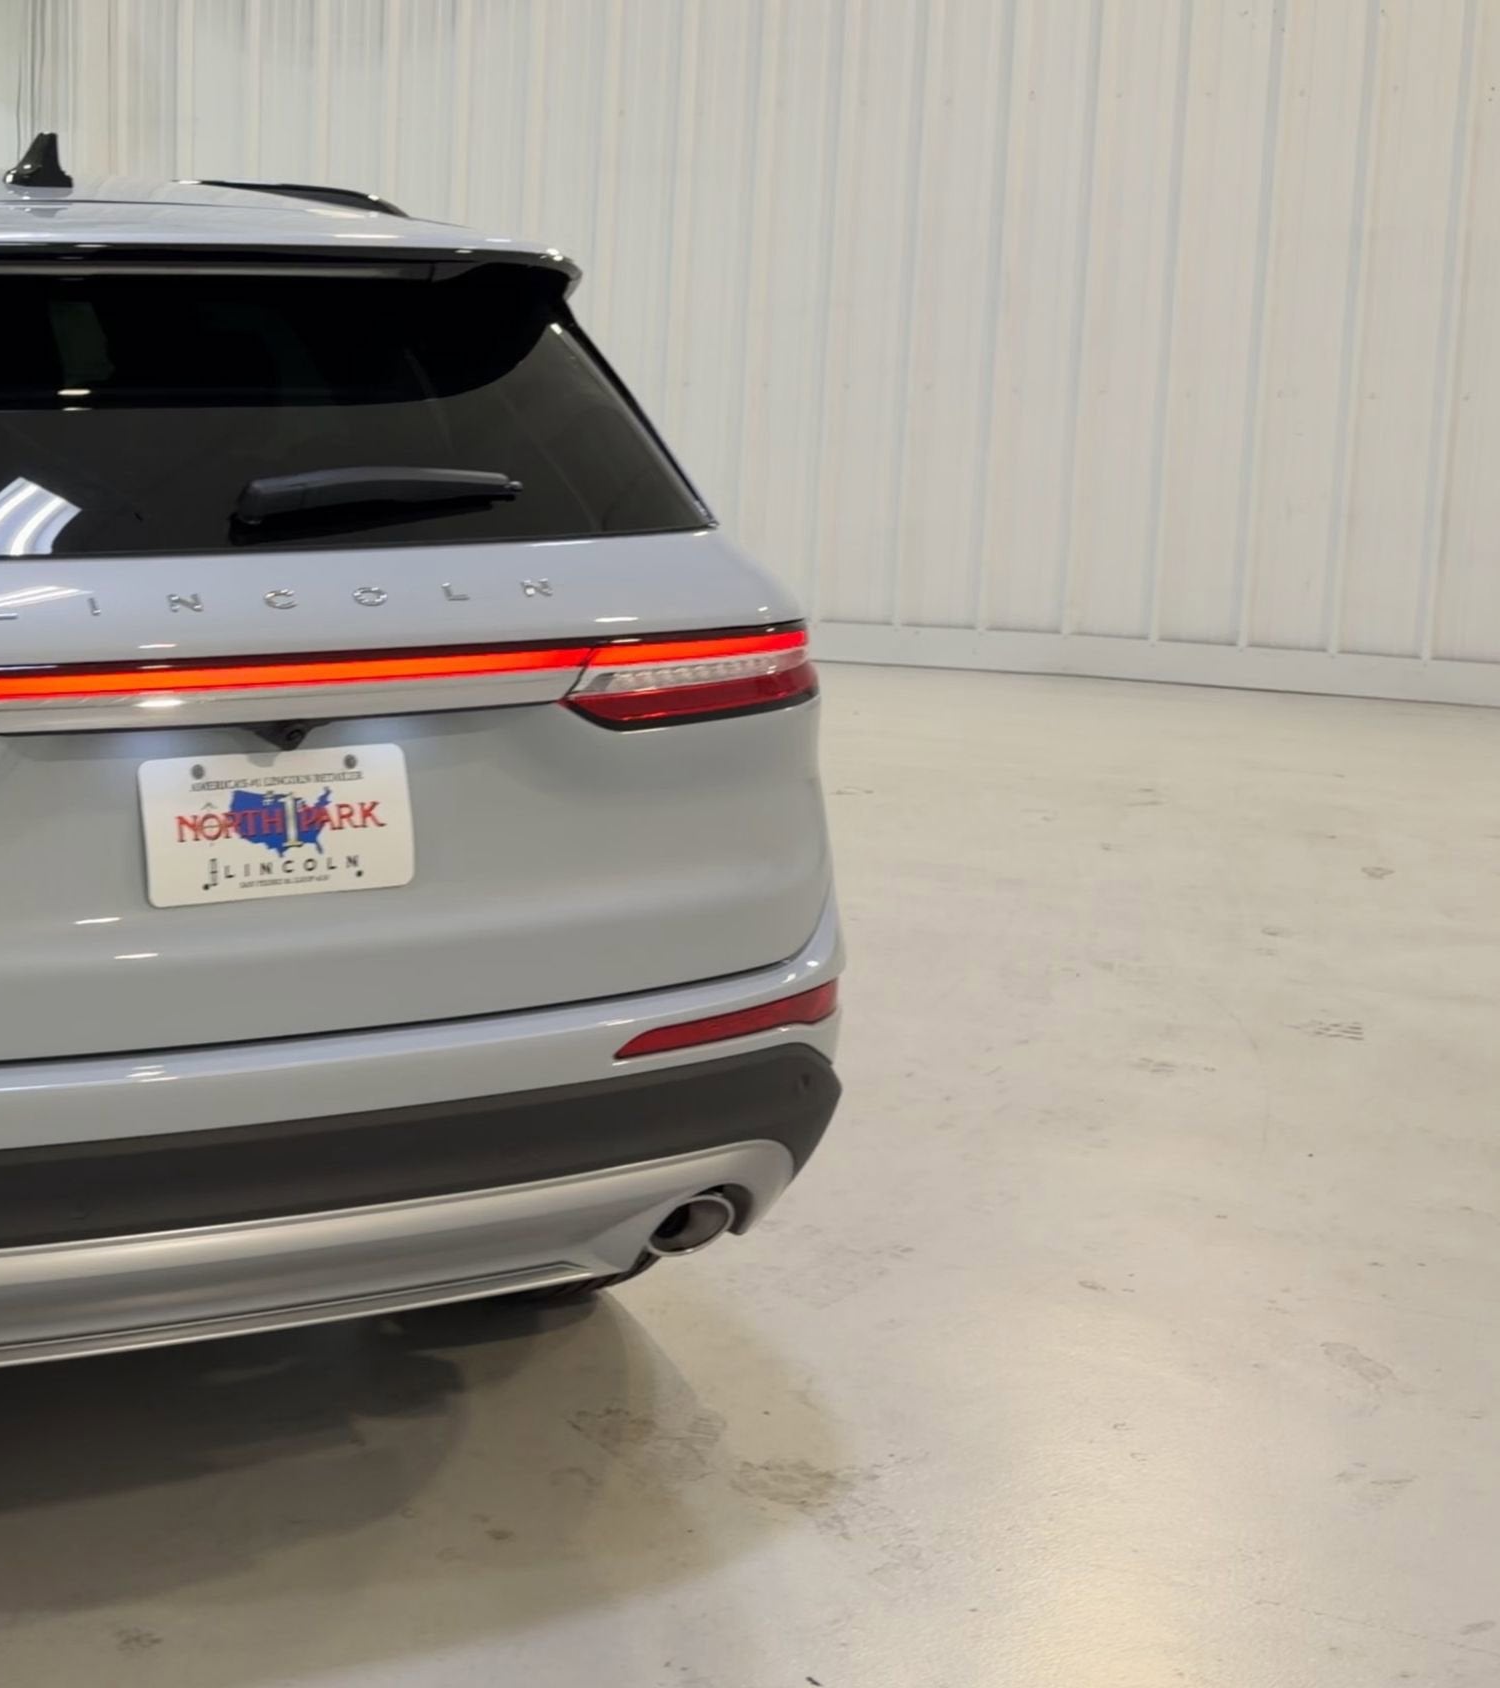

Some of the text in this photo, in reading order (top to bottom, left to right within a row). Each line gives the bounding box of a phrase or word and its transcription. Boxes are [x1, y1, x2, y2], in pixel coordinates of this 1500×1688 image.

[174, 800, 387, 843] NORTH PARK
[224, 855, 360, 879] LINCOLN
